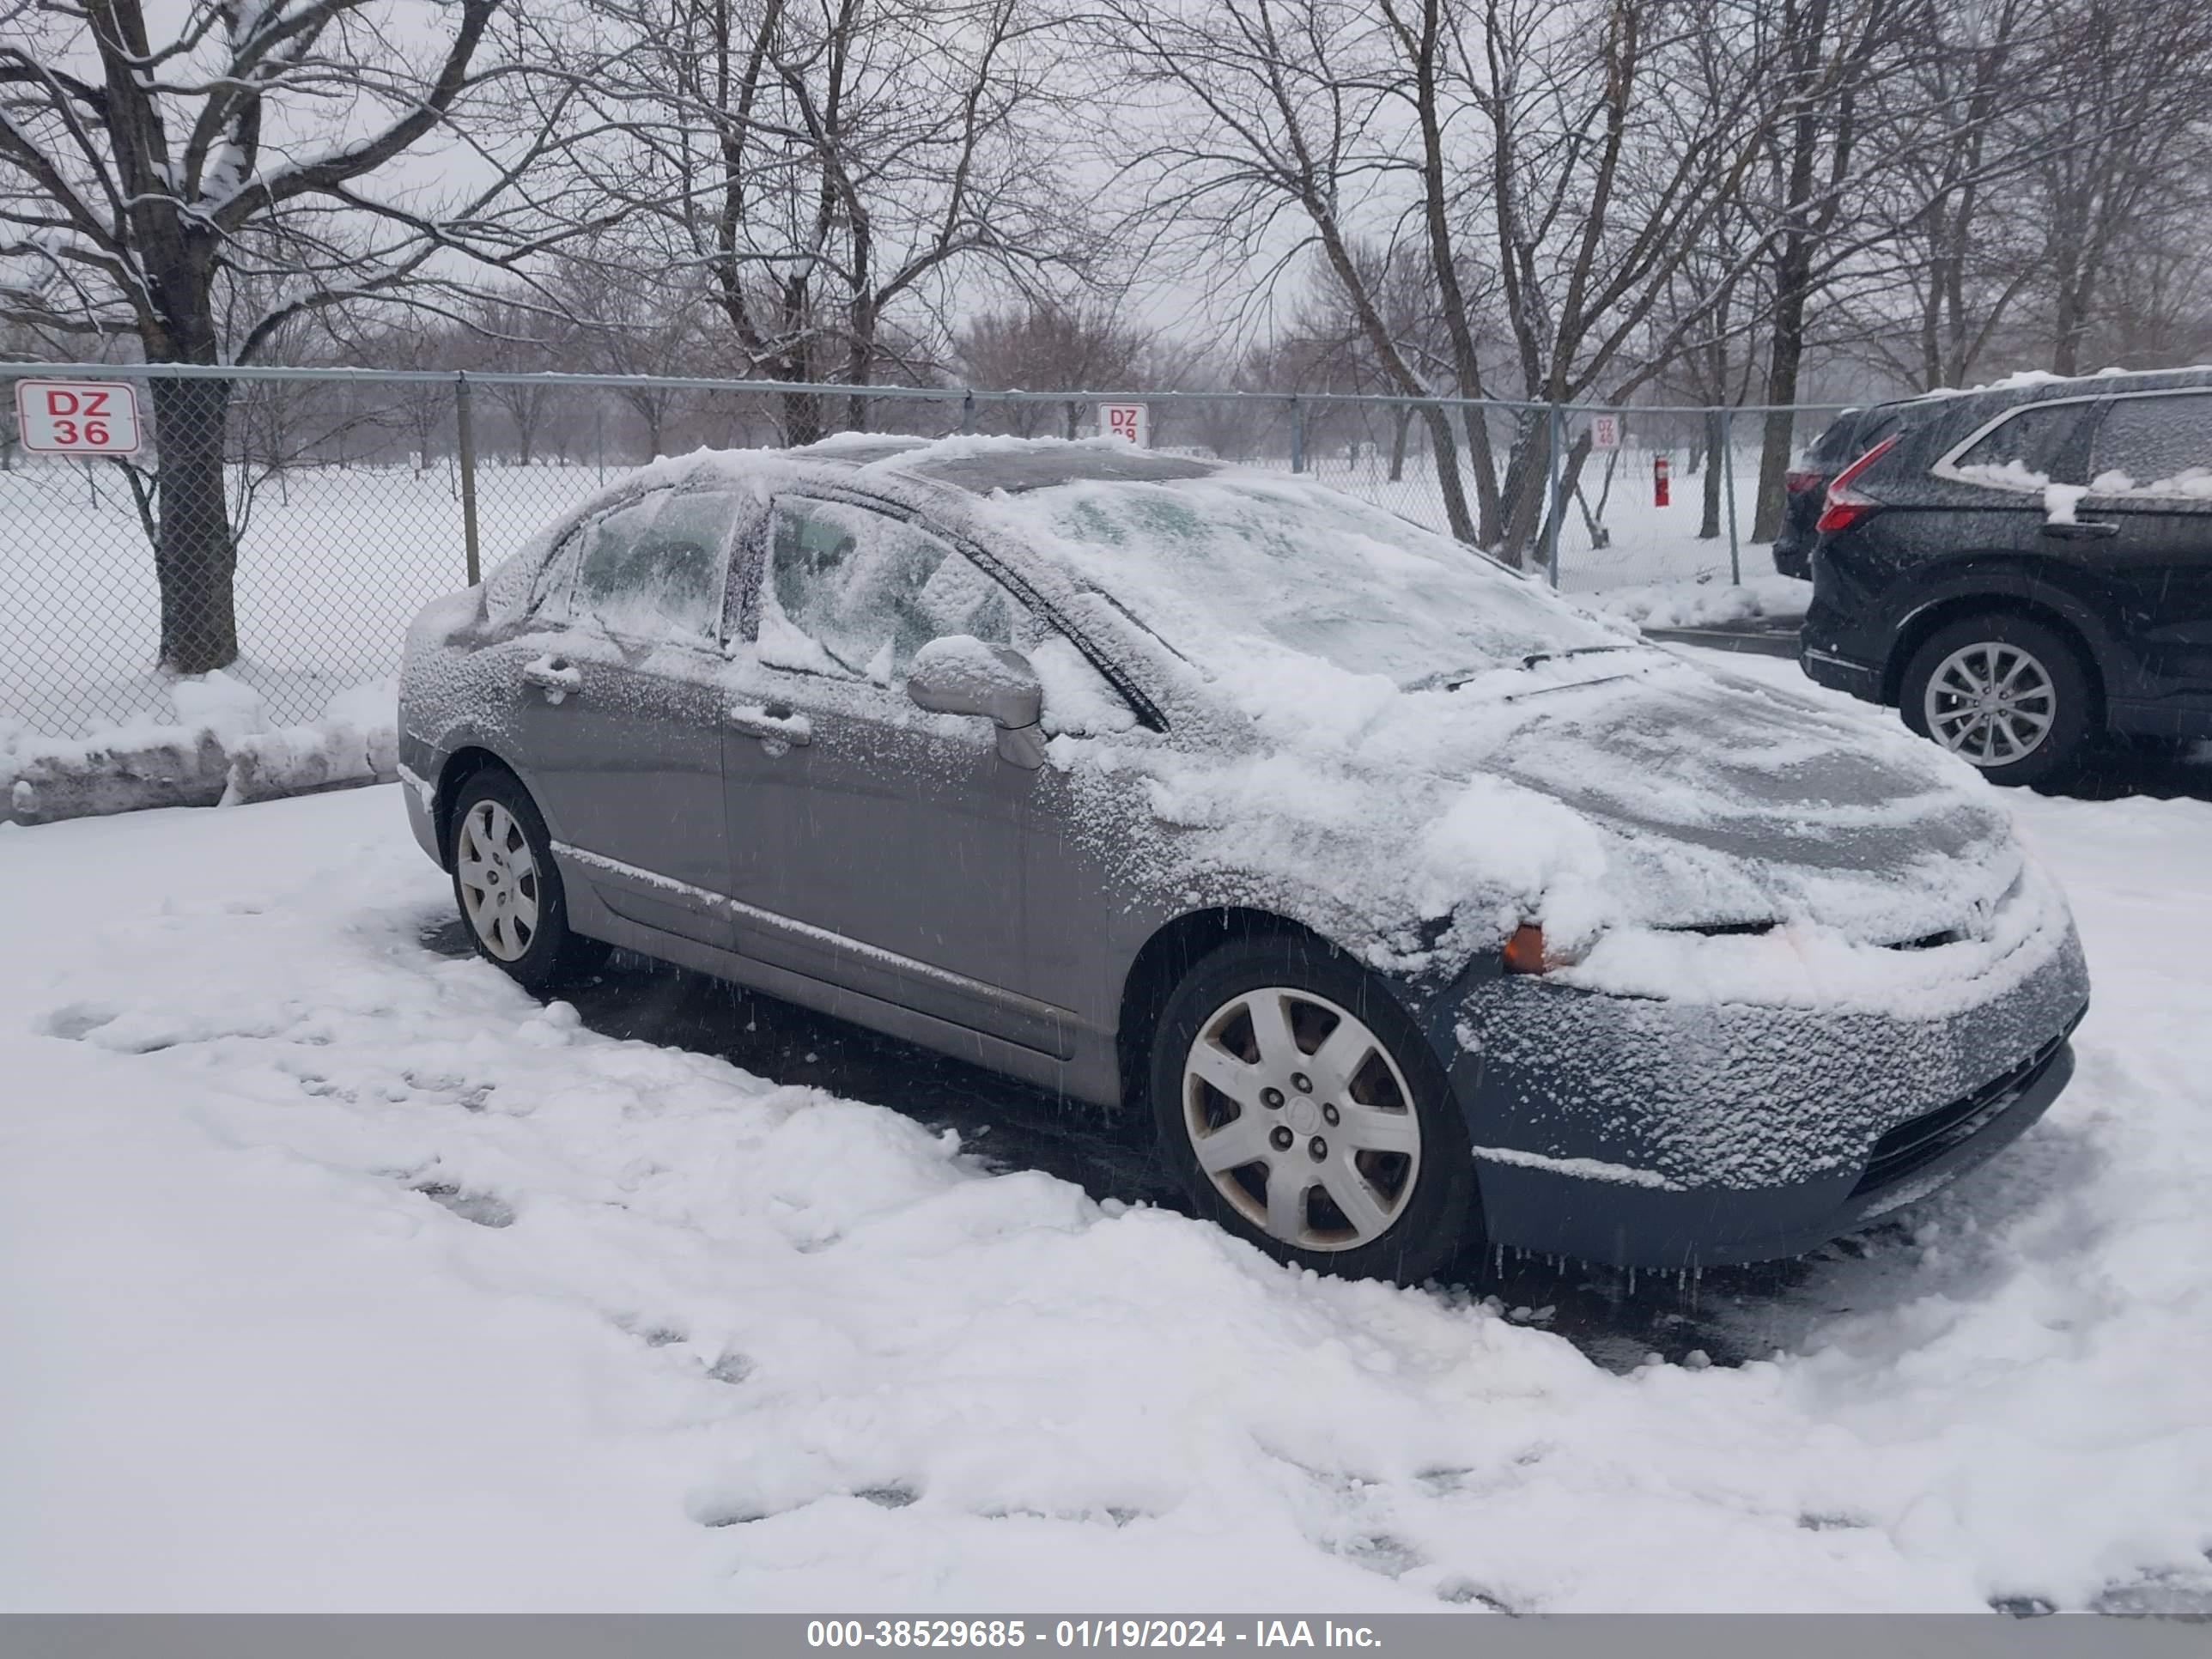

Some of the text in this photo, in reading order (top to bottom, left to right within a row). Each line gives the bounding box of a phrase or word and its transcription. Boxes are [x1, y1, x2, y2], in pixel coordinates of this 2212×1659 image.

[46, 390, 112, 417] DZ
[1110, 409, 1138, 427] DZ
[52, 420, 110, 446] 36
